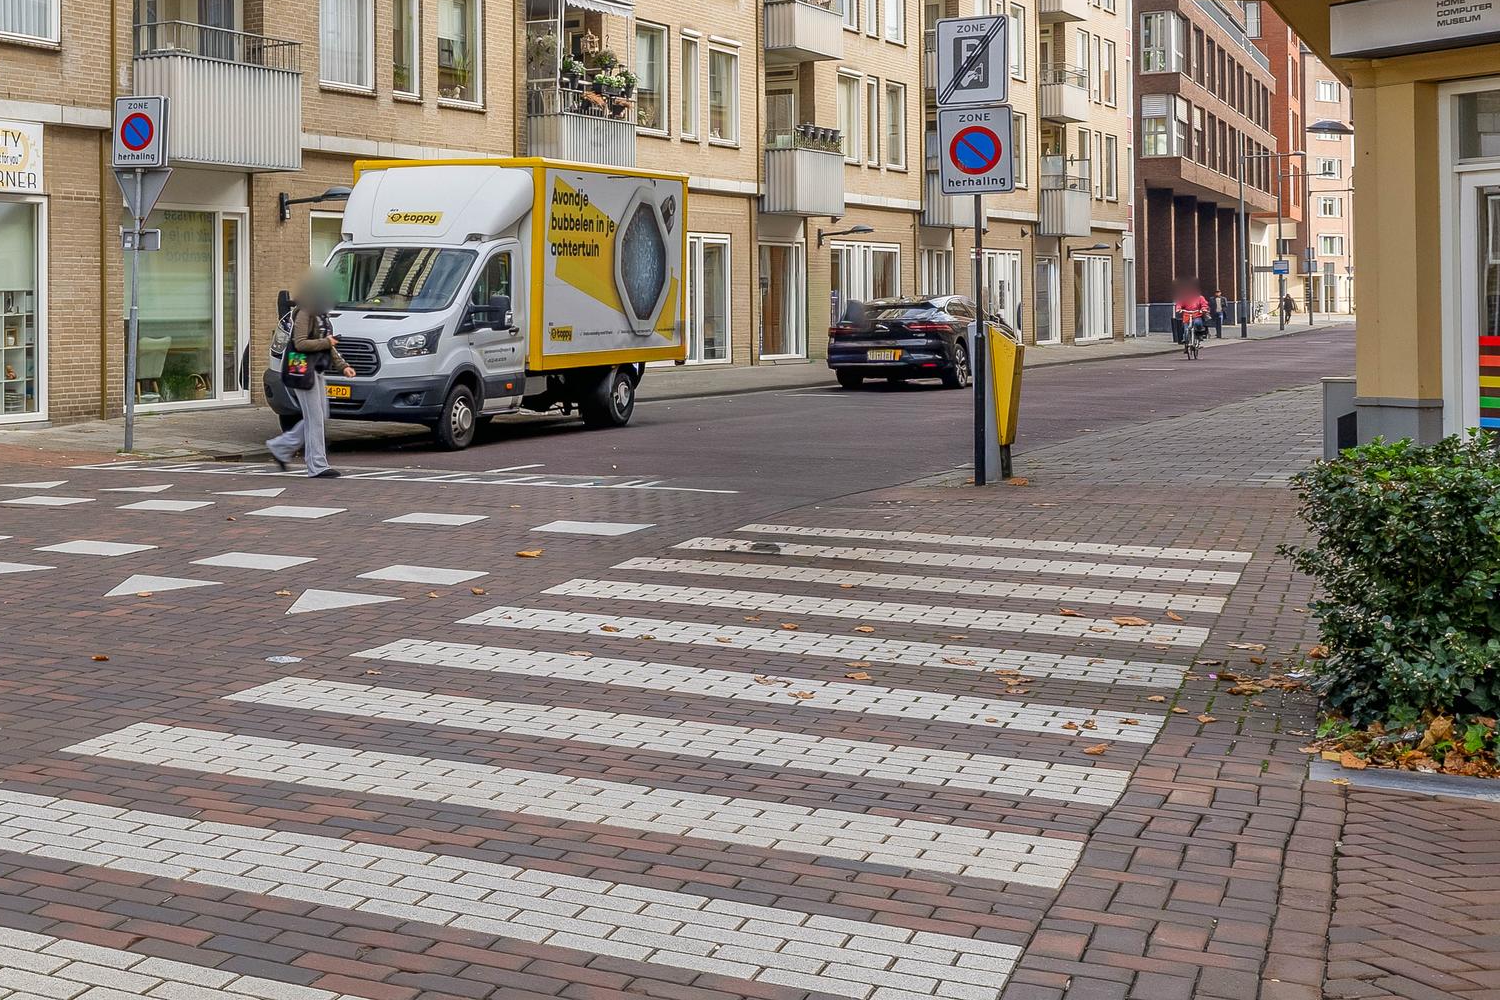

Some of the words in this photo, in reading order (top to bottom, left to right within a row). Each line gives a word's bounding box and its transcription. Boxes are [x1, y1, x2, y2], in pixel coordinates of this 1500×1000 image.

[1436, 3, 1492, 17] COMPUTER
[1436, 14, 1481, 27] MUSEUM
[956, 23, 986, 33] ZONE
[128, 102, 149, 110] ZONE
[958, 113, 991, 123] ZONE
[117, 152, 155, 162] herhaling
[948, 176, 1006, 187] herhaling
[551, 187, 589, 211] Avondje
[403, 213, 437, 224] toppy
[551, 212, 594, 233] bubbelen
[596, 215, 604, 233] in
[605, 218, 615, 238] je
[550, 238, 600, 257] achtertuin
[556, 329, 572, 341] toppy
